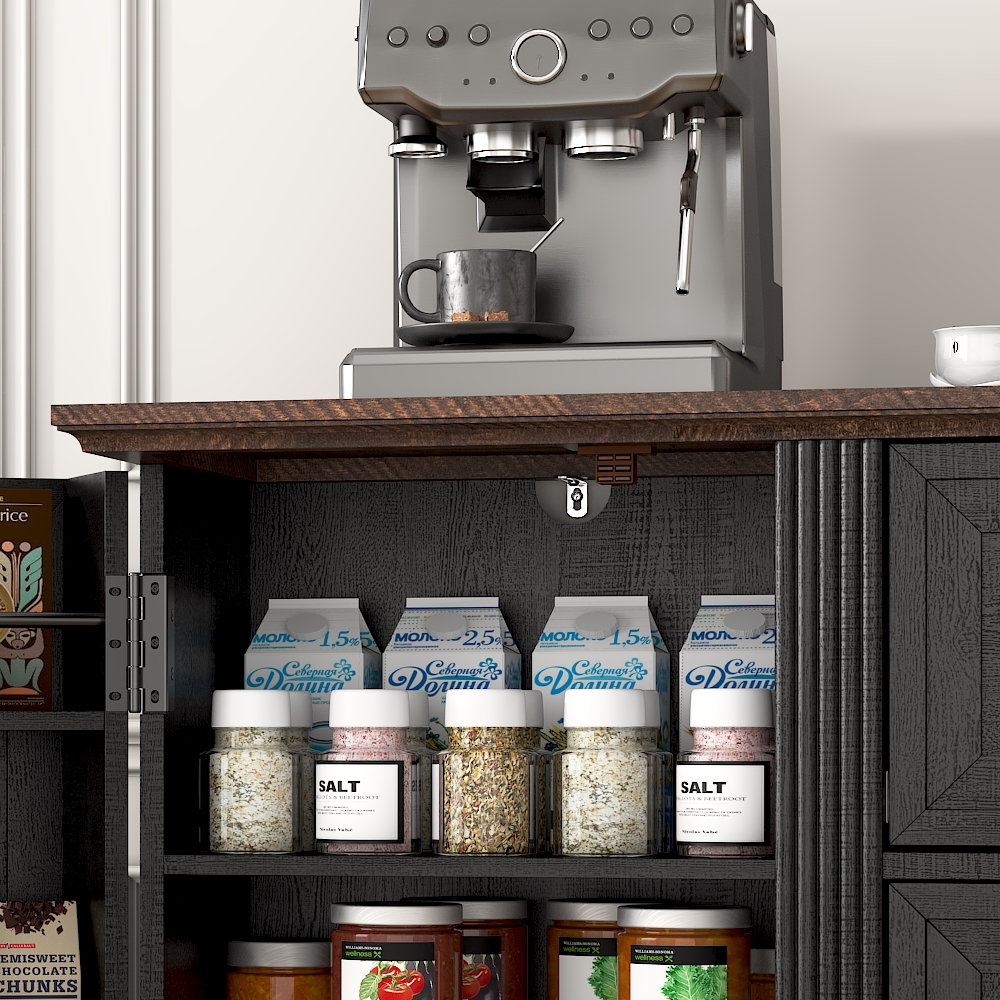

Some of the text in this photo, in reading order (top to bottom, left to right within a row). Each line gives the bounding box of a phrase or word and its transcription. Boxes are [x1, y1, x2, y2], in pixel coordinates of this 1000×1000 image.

[0, 507, 28, 522] rice
[319, 630, 360, 650] 1,5%
[609, 628, 651, 648] 1,5%
[282, 660, 337, 678] Северная
[426, 659, 483, 678] Северная
[572, 660, 629, 678] Северная
[319, 780, 360, 792] SALT
[681, 781, 726, 793] SALT
